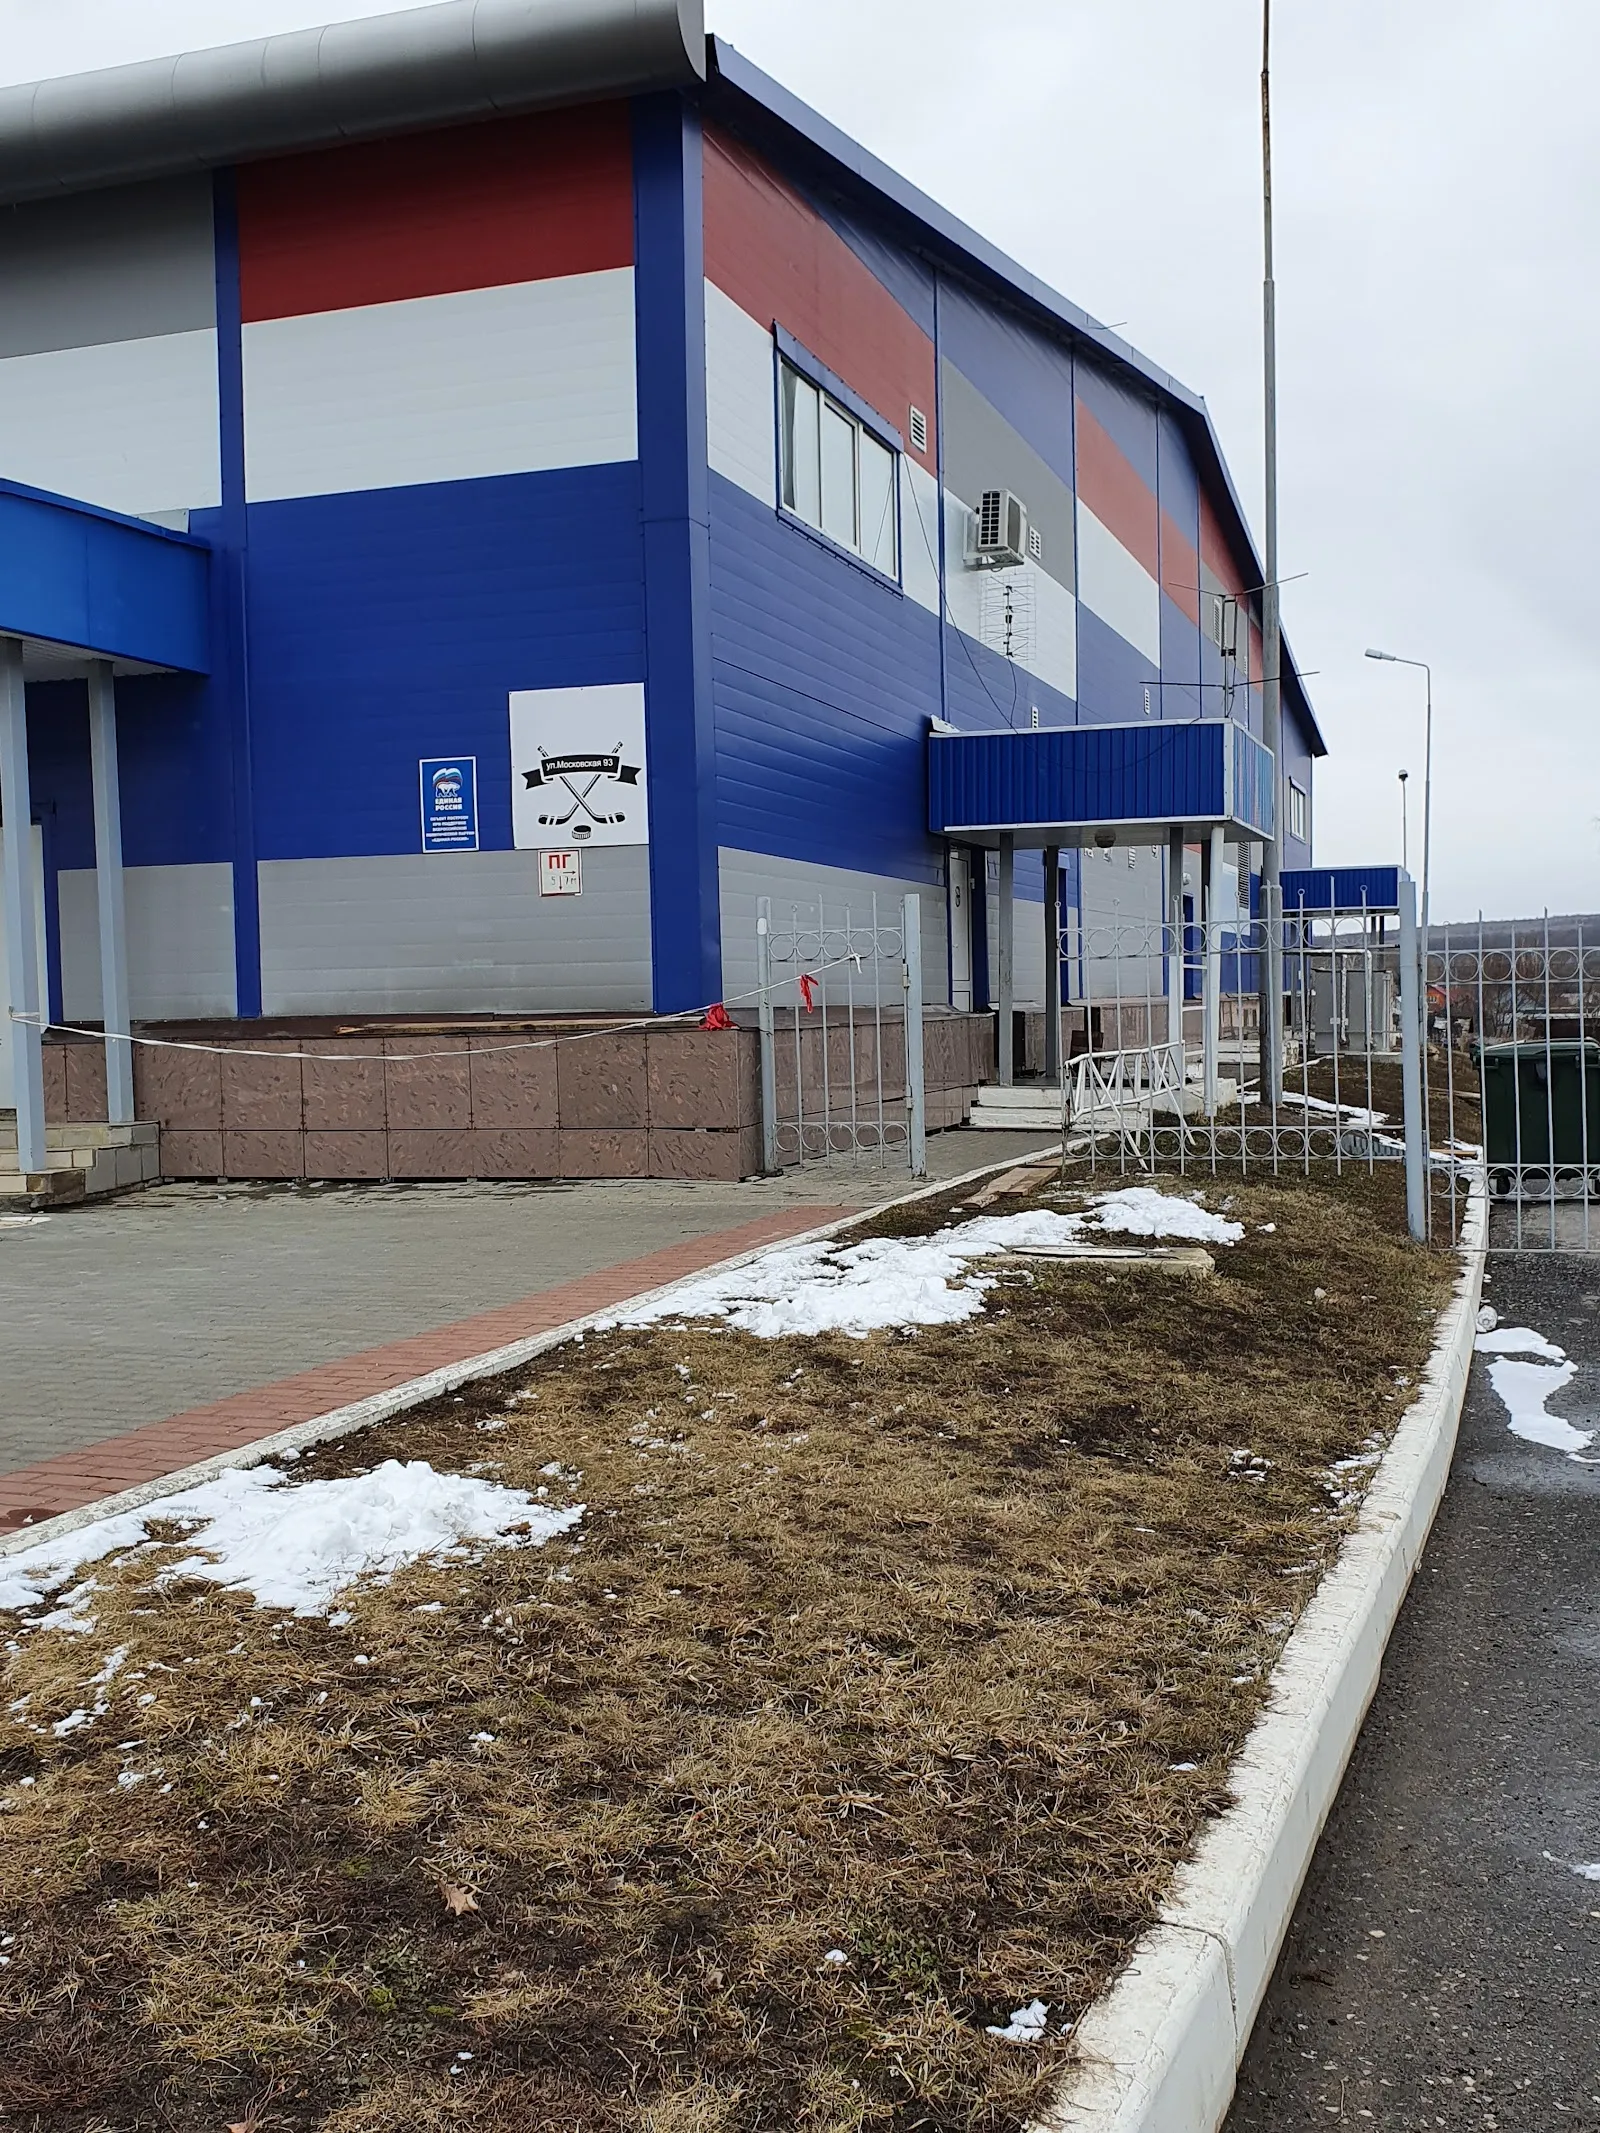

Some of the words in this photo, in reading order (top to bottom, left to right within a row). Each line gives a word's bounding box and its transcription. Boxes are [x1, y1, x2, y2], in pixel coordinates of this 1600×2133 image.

[603, 758, 613, 767] 93
[435, 797, 462, 805] ЕДИНАЯ
[549, 854, 571, 869] ПГ
